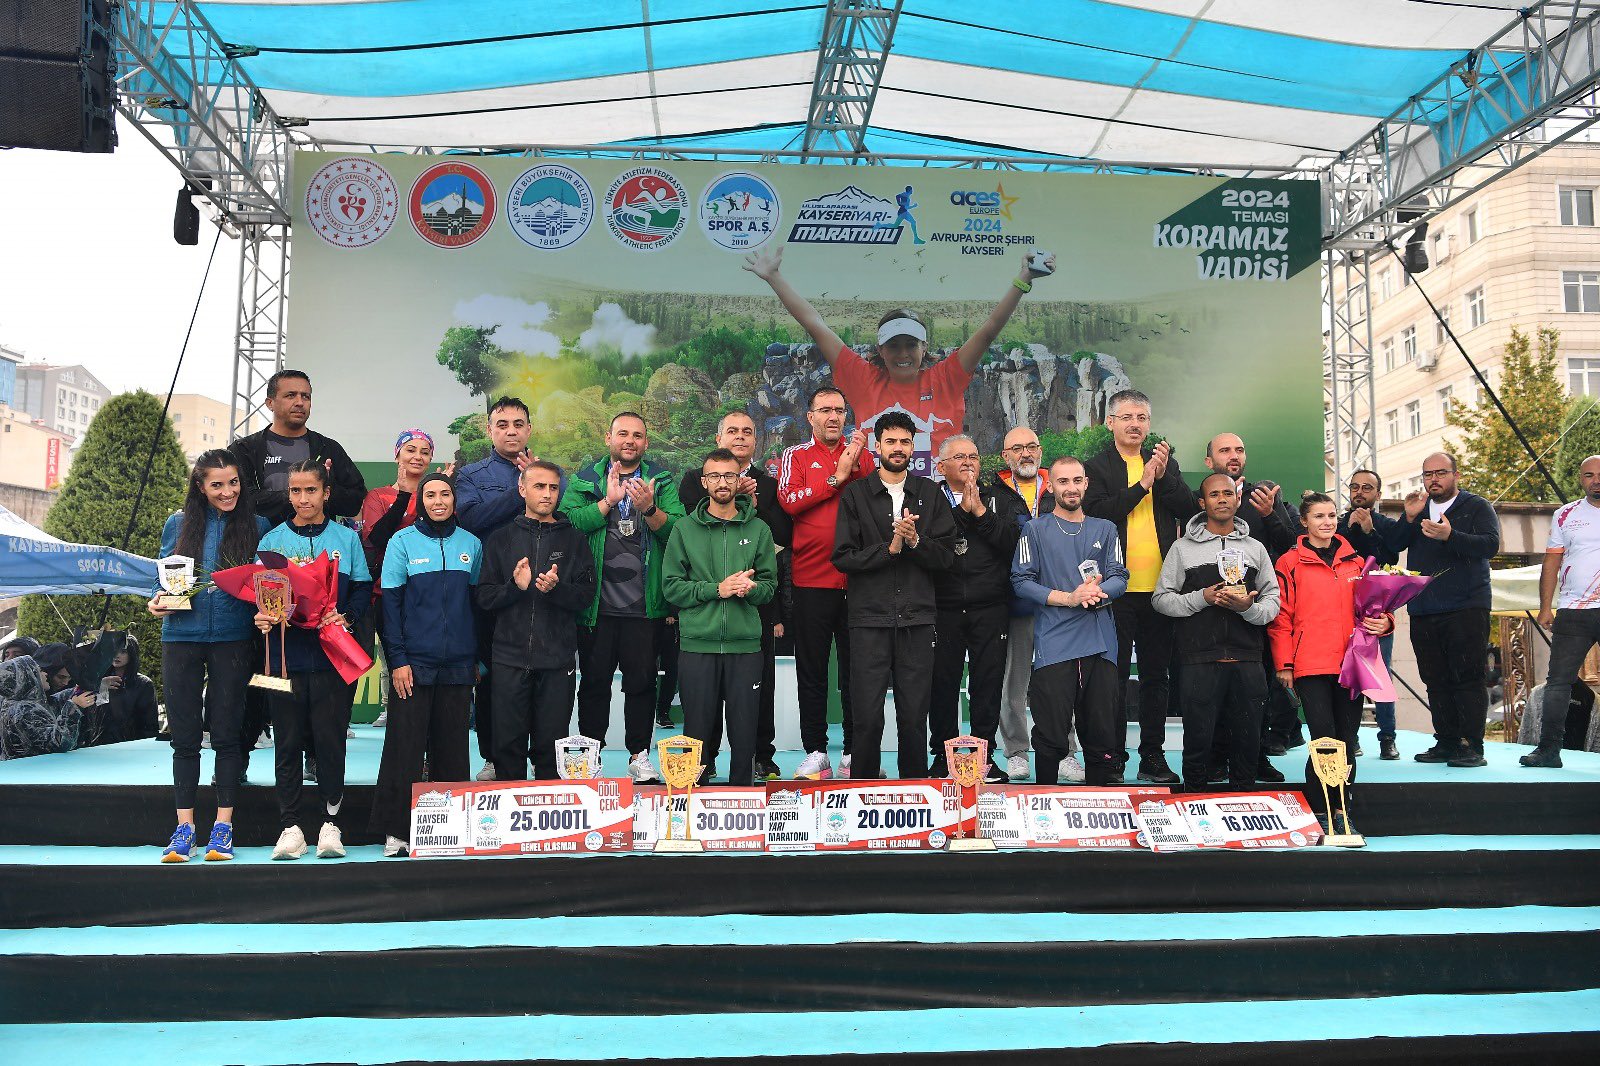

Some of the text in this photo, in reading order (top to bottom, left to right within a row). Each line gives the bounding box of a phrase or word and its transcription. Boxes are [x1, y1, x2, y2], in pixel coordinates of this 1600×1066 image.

[446, 165, 463, 173] T.C.
[604, 166, 689, 208] TÜRKİYE ATLETİZM FEDERASYONU
[512, 168, 590, 226] KAYSERİ BÜYÜKŞEHİR BELEDİYESİ
[950, 190, 1000, 207] aces
[1221, 189, 1290, 208] 2024
[1231, 210, 1289, 223] TEMASI
[606, 214, 686, 250] TURKISH ATHLETIC FEDERATION
[708, 220, 772, 235] SPOR A.Ş.
[964, 218, 1002, 232] 2024
[794, 226, 899, 242] MARATONU
[930, 233, 1035, 246] AVRUPA SPOR ŞEHRİ
[1153, 223, 1289, 251] KORAMAZ
[539, 238, 560, 246] 1869
[961, 246, 1004, 256] KAYSERİ
[1196, 254, 1289, 282] VADİSİ
[264, 455, 282, 466] STAFF
[77, 559, 126, 576] SPOR A.Ş.
[598, 781, 620, 797] ÖDÜL
[476, 794, 502, 811] 21K
[599, 798, 619, 814] ÇEKİ
[826, 793, 849, 809] 21K
[1031, 796, 1052, 811] 21K
[1188, 803, 1209, 816] 21K
[416, 813, 448, 824] KAYSERİ
[510, 809, 591, 832] 25.000TL
[768, 821, 785, 831] YARI
[857, 809, 935, 829] 20.000TL
[1064, 811, 1138, 830] 18.000TL
[1221, 814, 1289, 832] 16.000TL
[416, 824, 434, 835] YARI
[768, 831, 809, 842] MARATONU
[415, 835, 459, 846] MARATONU
[520, 842, 542, 852] GENEL
[543, 841, 577, 851] KLASMAN
[706, 841, 728, 849] GENEL
[728, 840, 761, 849] KLASMAN
[867, 839, 887, 849] GENEL
[889, 839, 921, 848] KLASMAN
[1078, 839, 1099, 847] GENEL
